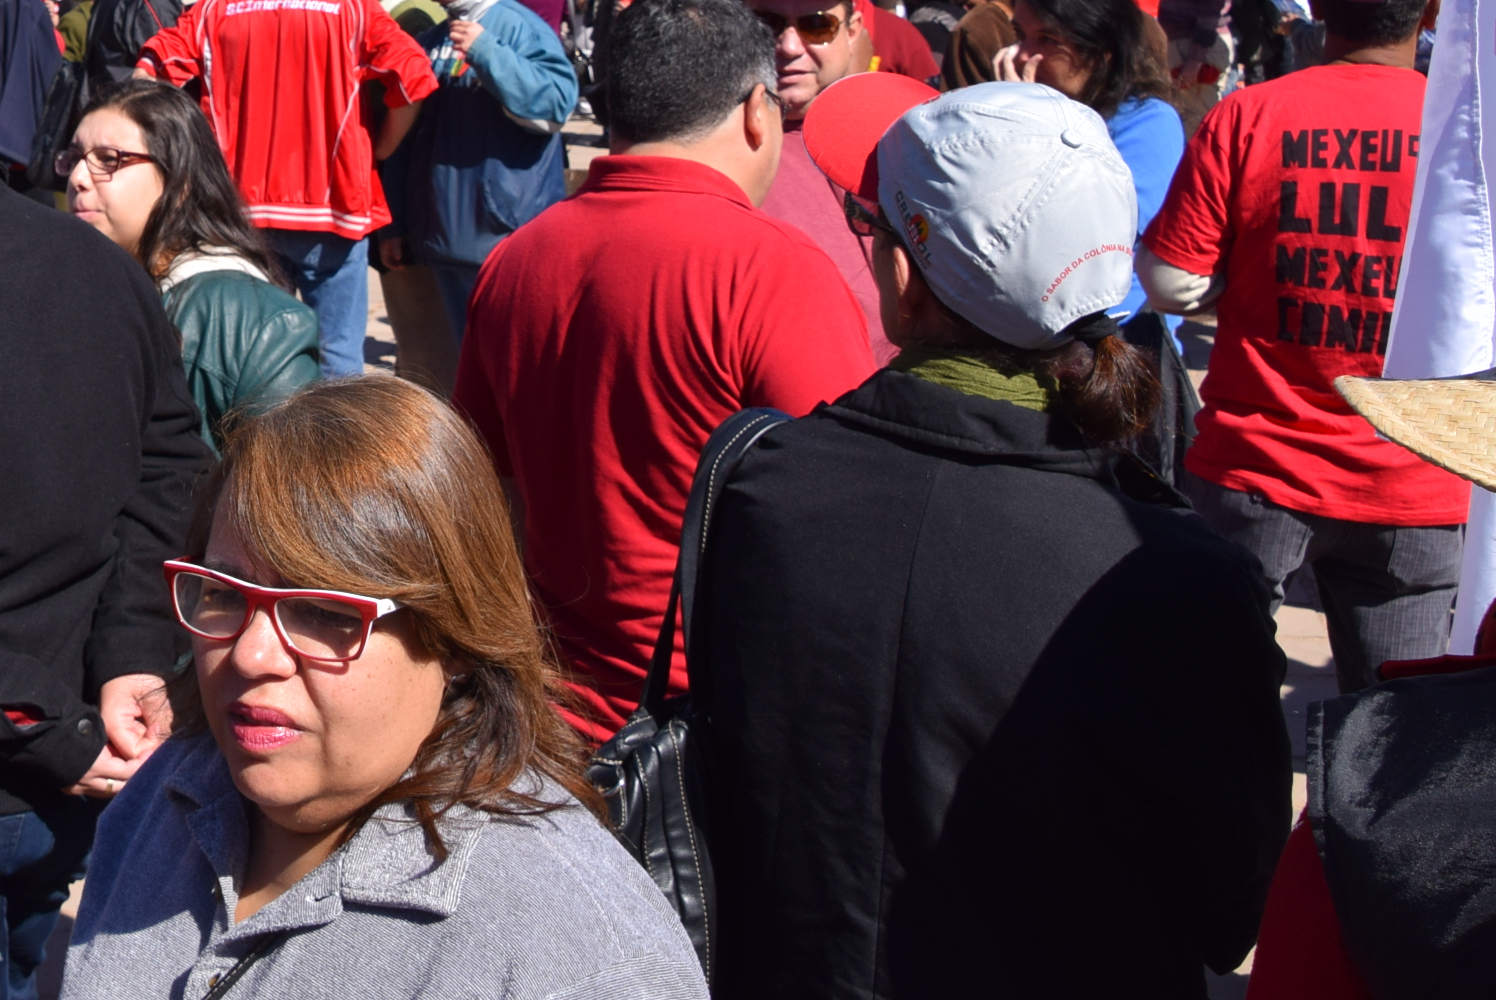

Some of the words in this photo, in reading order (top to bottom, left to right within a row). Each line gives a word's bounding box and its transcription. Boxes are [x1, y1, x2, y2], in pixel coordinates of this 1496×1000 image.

[1281, 128, 1403, 173] MEXEU
[1277, 180, 1402, 243] LUL
[1041, 295, 1050, 303] O
[1046, 266, 1073, 295] SABOR
[1071, 257, 1084, 270] DA
[1084, 244, 1117, 261] COLÔNIA
[1116, 244, 1126, 253] NA
